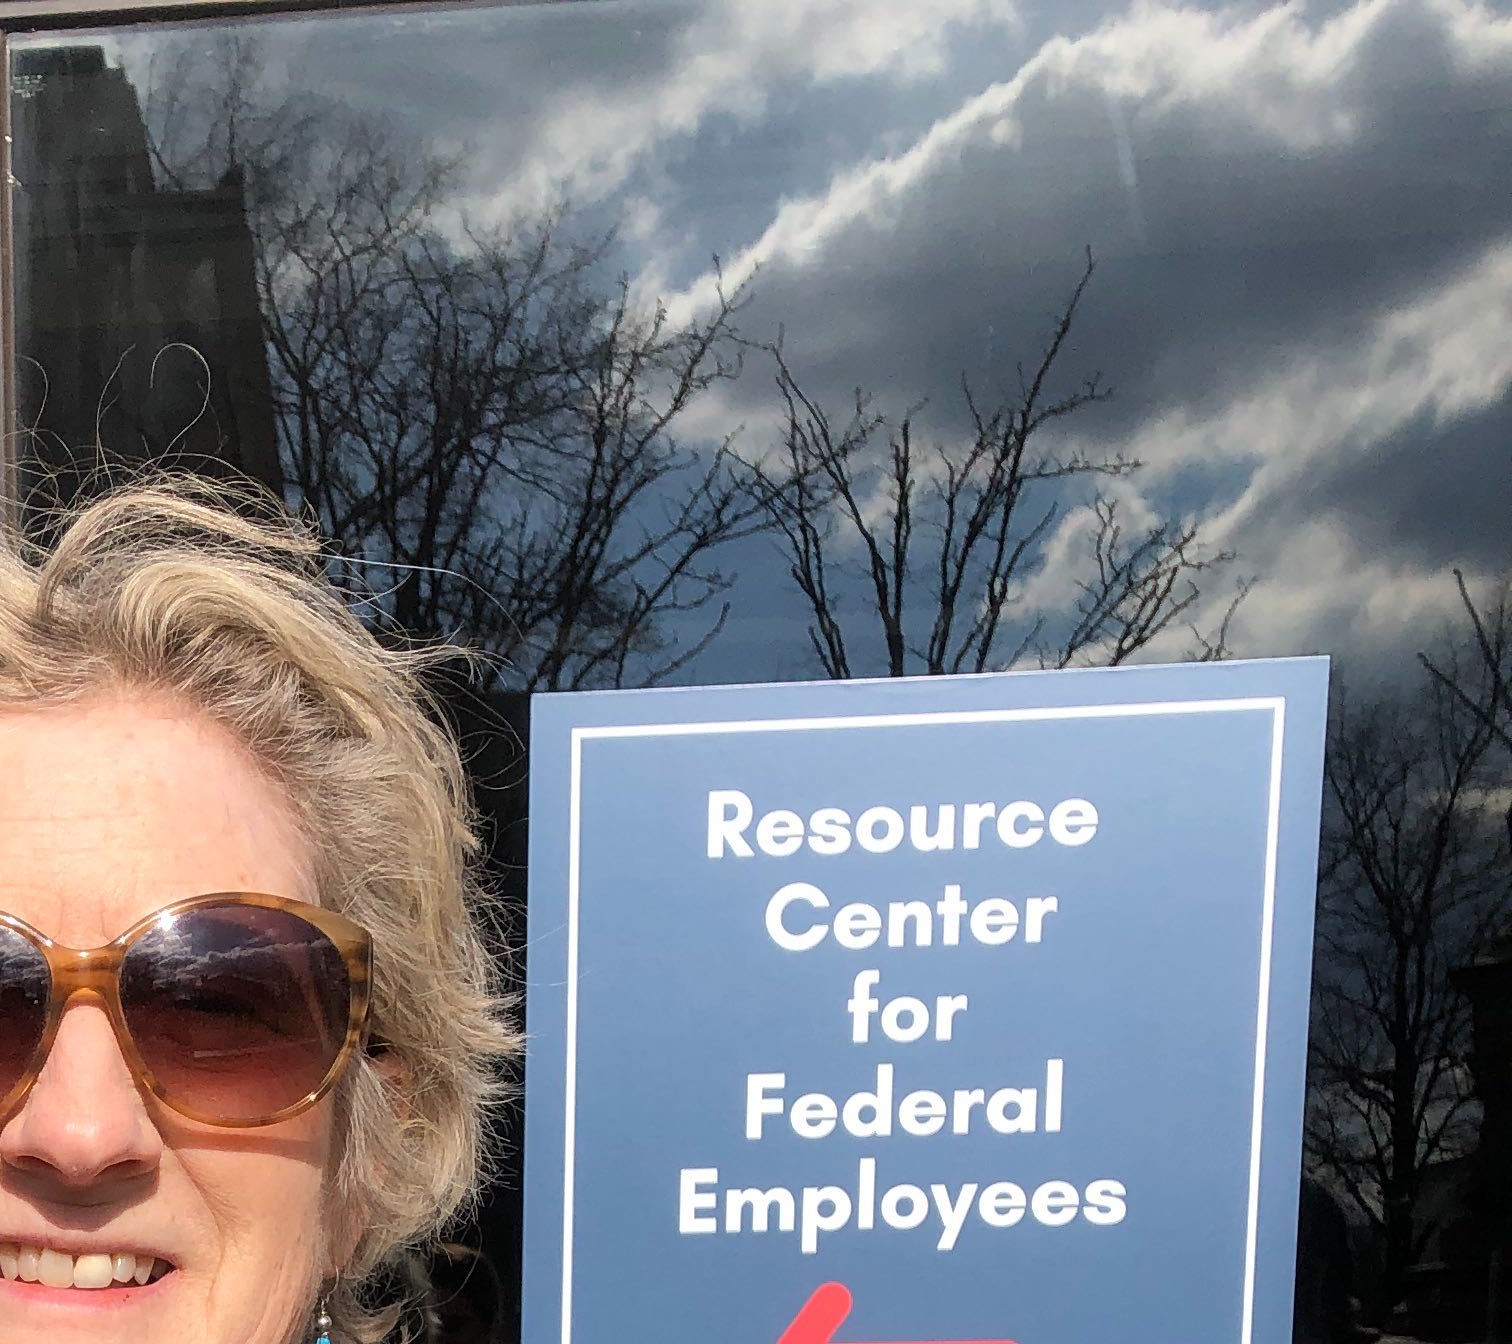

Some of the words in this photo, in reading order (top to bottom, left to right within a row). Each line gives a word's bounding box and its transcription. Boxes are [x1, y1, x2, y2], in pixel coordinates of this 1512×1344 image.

[707, 790, 1099, 858] Resource
[765, 883, 1058, 951] Center
[847, 970, 968, 1043] for
[746, 1059, 1064, 1139] Federal
[679, 1158, 1127, 1254] Employees
